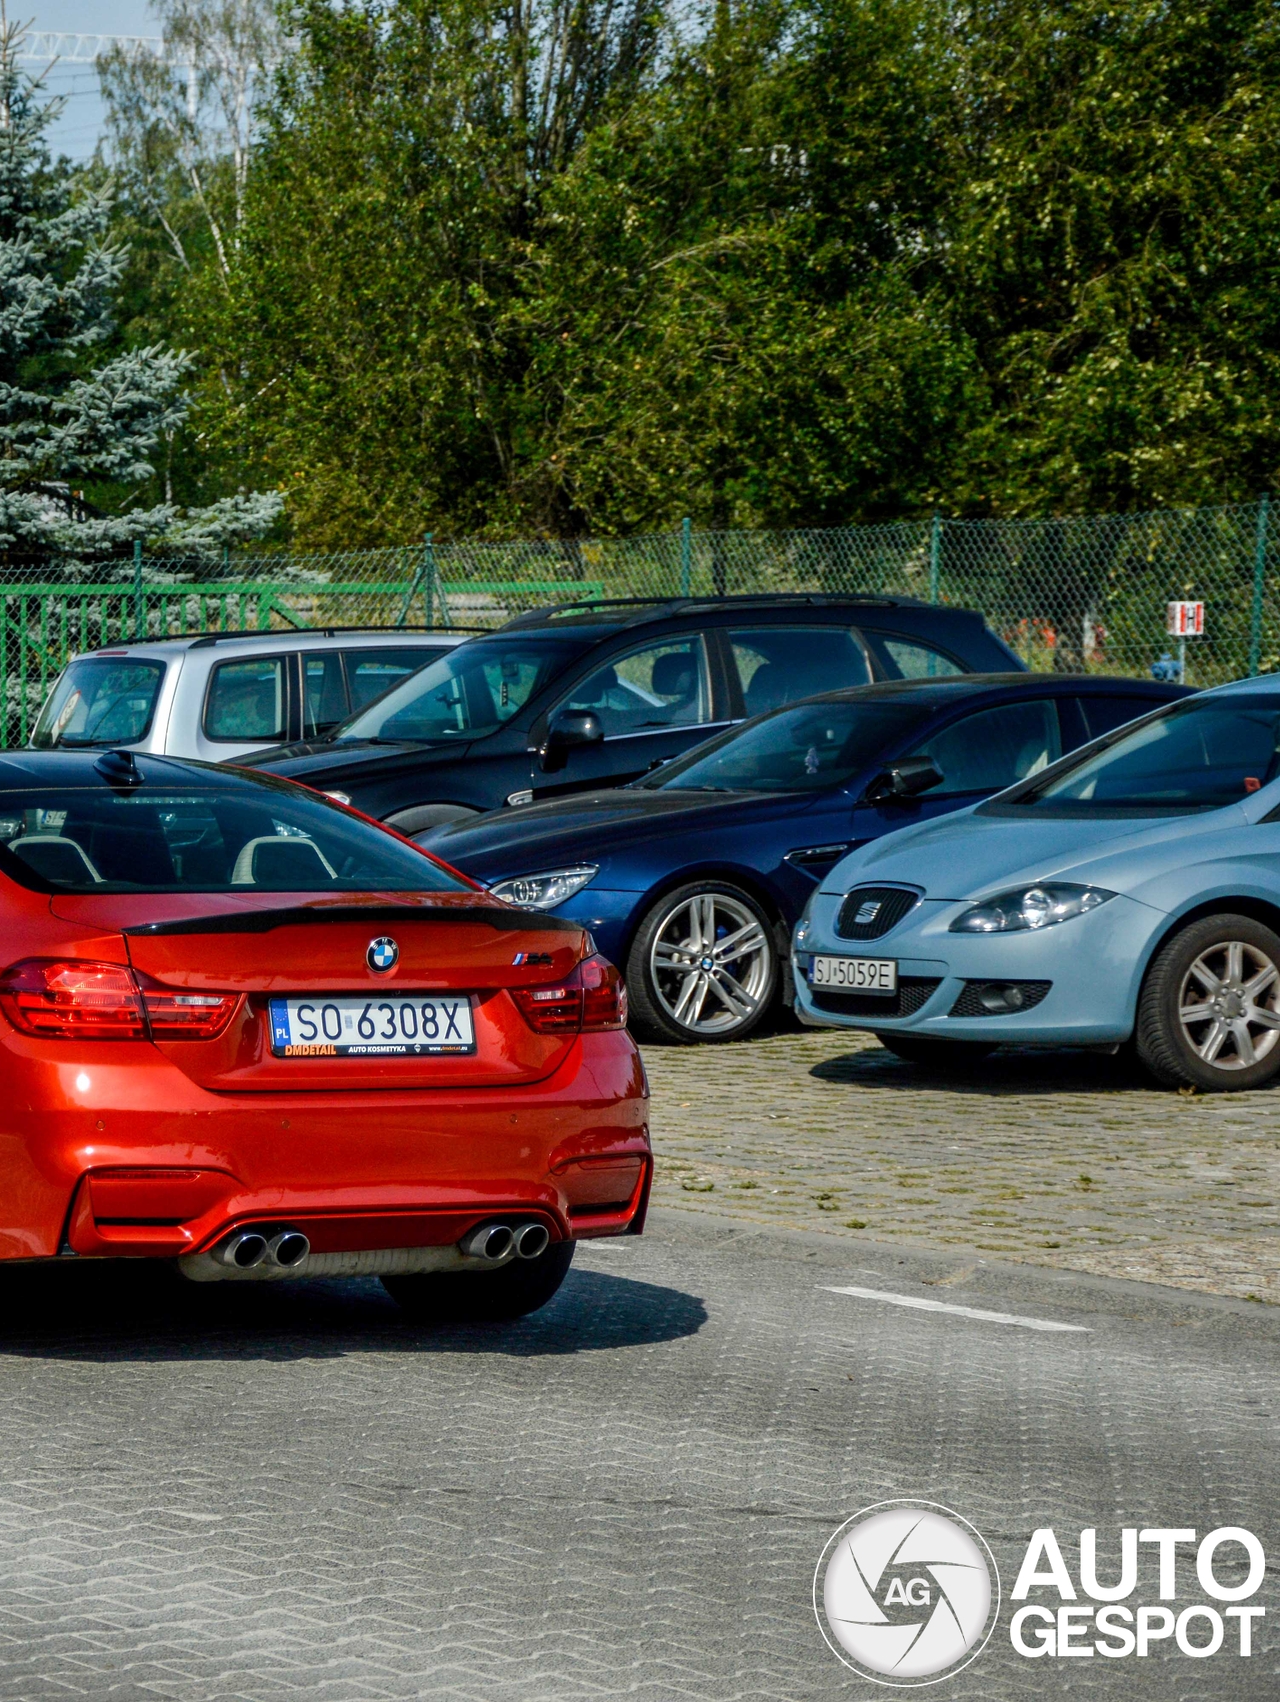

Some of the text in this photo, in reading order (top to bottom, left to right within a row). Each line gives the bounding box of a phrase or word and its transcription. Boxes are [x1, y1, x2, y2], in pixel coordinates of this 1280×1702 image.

[372, 938, 397, 950] BMW
[816, 959, 890, 988] SJ 5059E
[297, 1003, 462, 1041] SO 6308X
[276, 1028, 289, 1039] PL
[284, 1044, 337, 1056] DMDETAIL
[348, 1045, 406, 1054] AUTO KOSMETYKA
